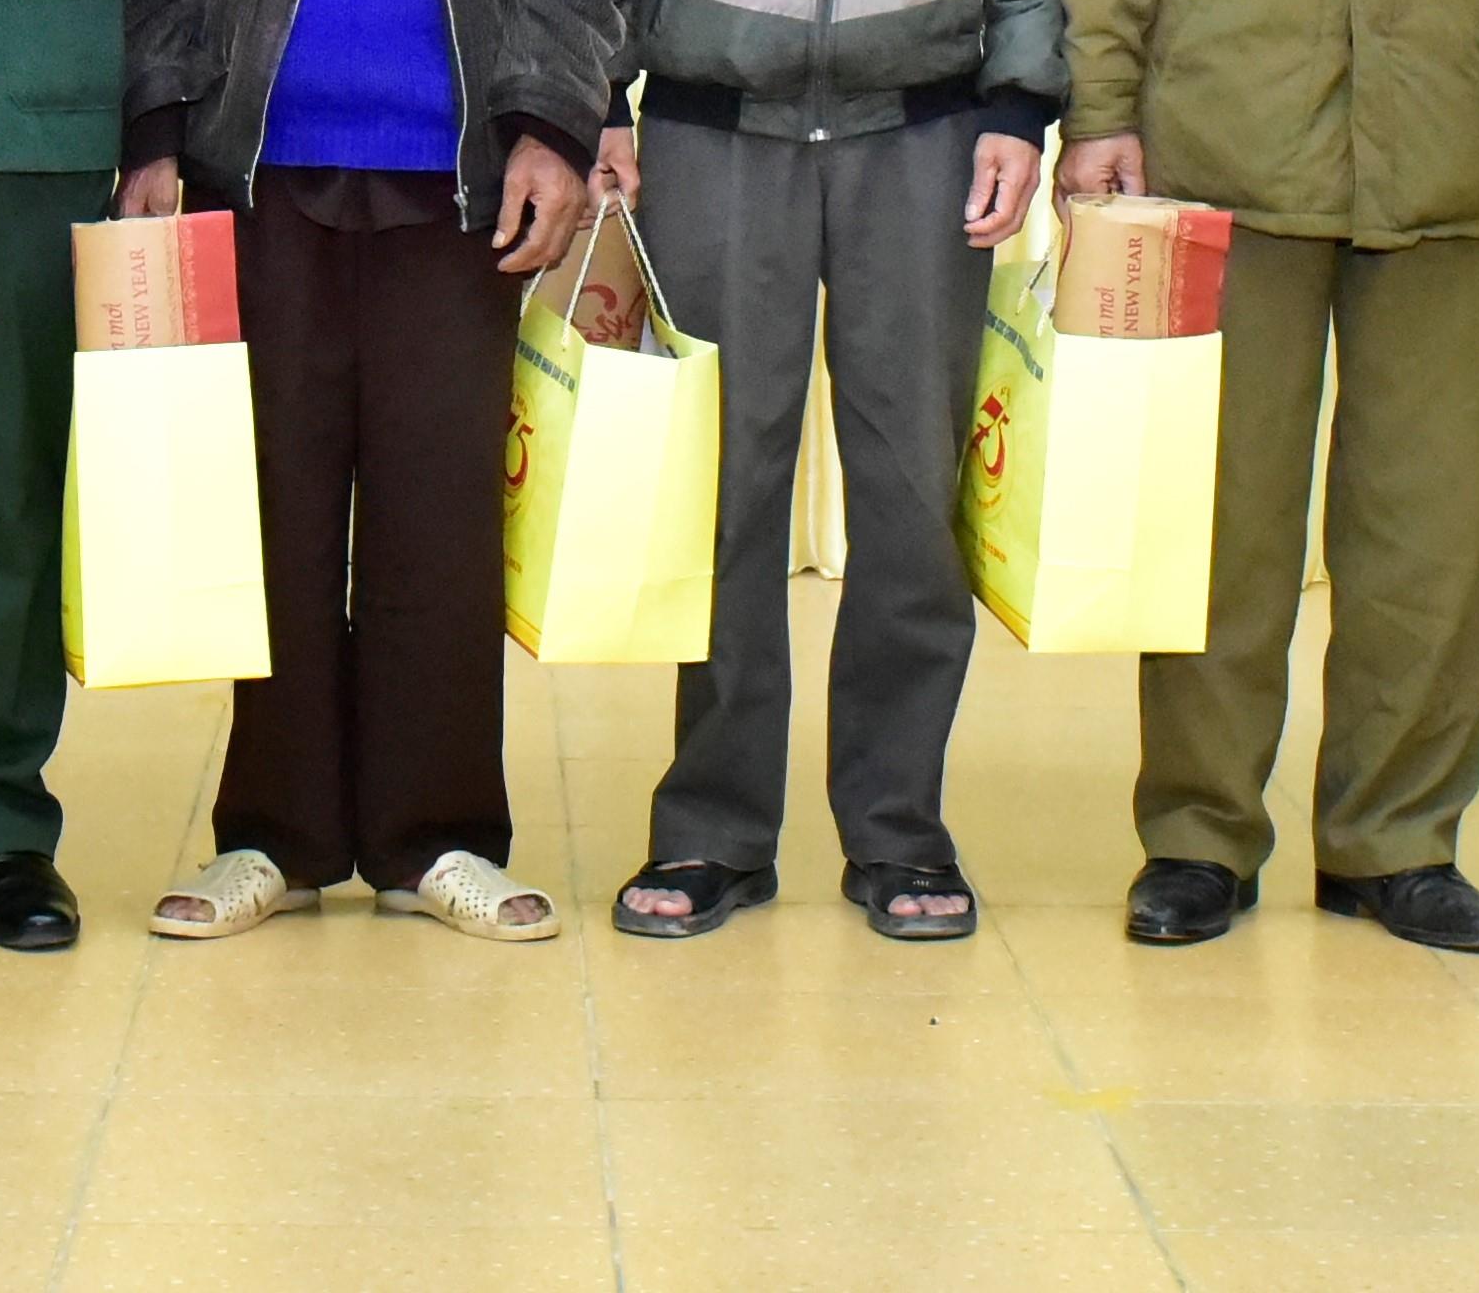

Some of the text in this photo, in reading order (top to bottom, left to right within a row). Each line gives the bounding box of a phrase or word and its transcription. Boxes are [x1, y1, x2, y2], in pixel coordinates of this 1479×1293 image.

[130, 248, 151, 348] NEW YEAR
[1124, 236, 1143, 332] NEW YEAR
